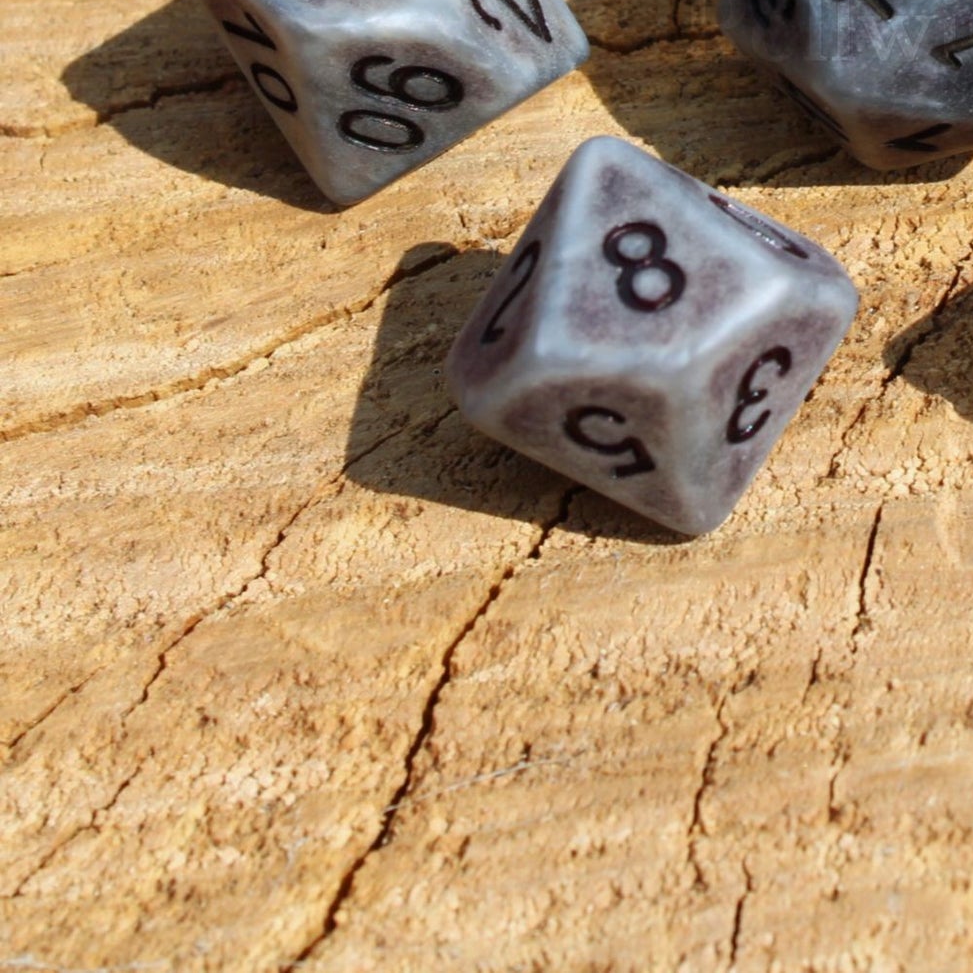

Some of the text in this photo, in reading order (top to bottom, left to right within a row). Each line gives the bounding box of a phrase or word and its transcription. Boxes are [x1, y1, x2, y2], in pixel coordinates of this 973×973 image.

[481, 239, 541, 345] 2
[603, 221, 686, 312] 8
[563, 405, 656, 479] 5
[726, 345, 792, 444] 3
